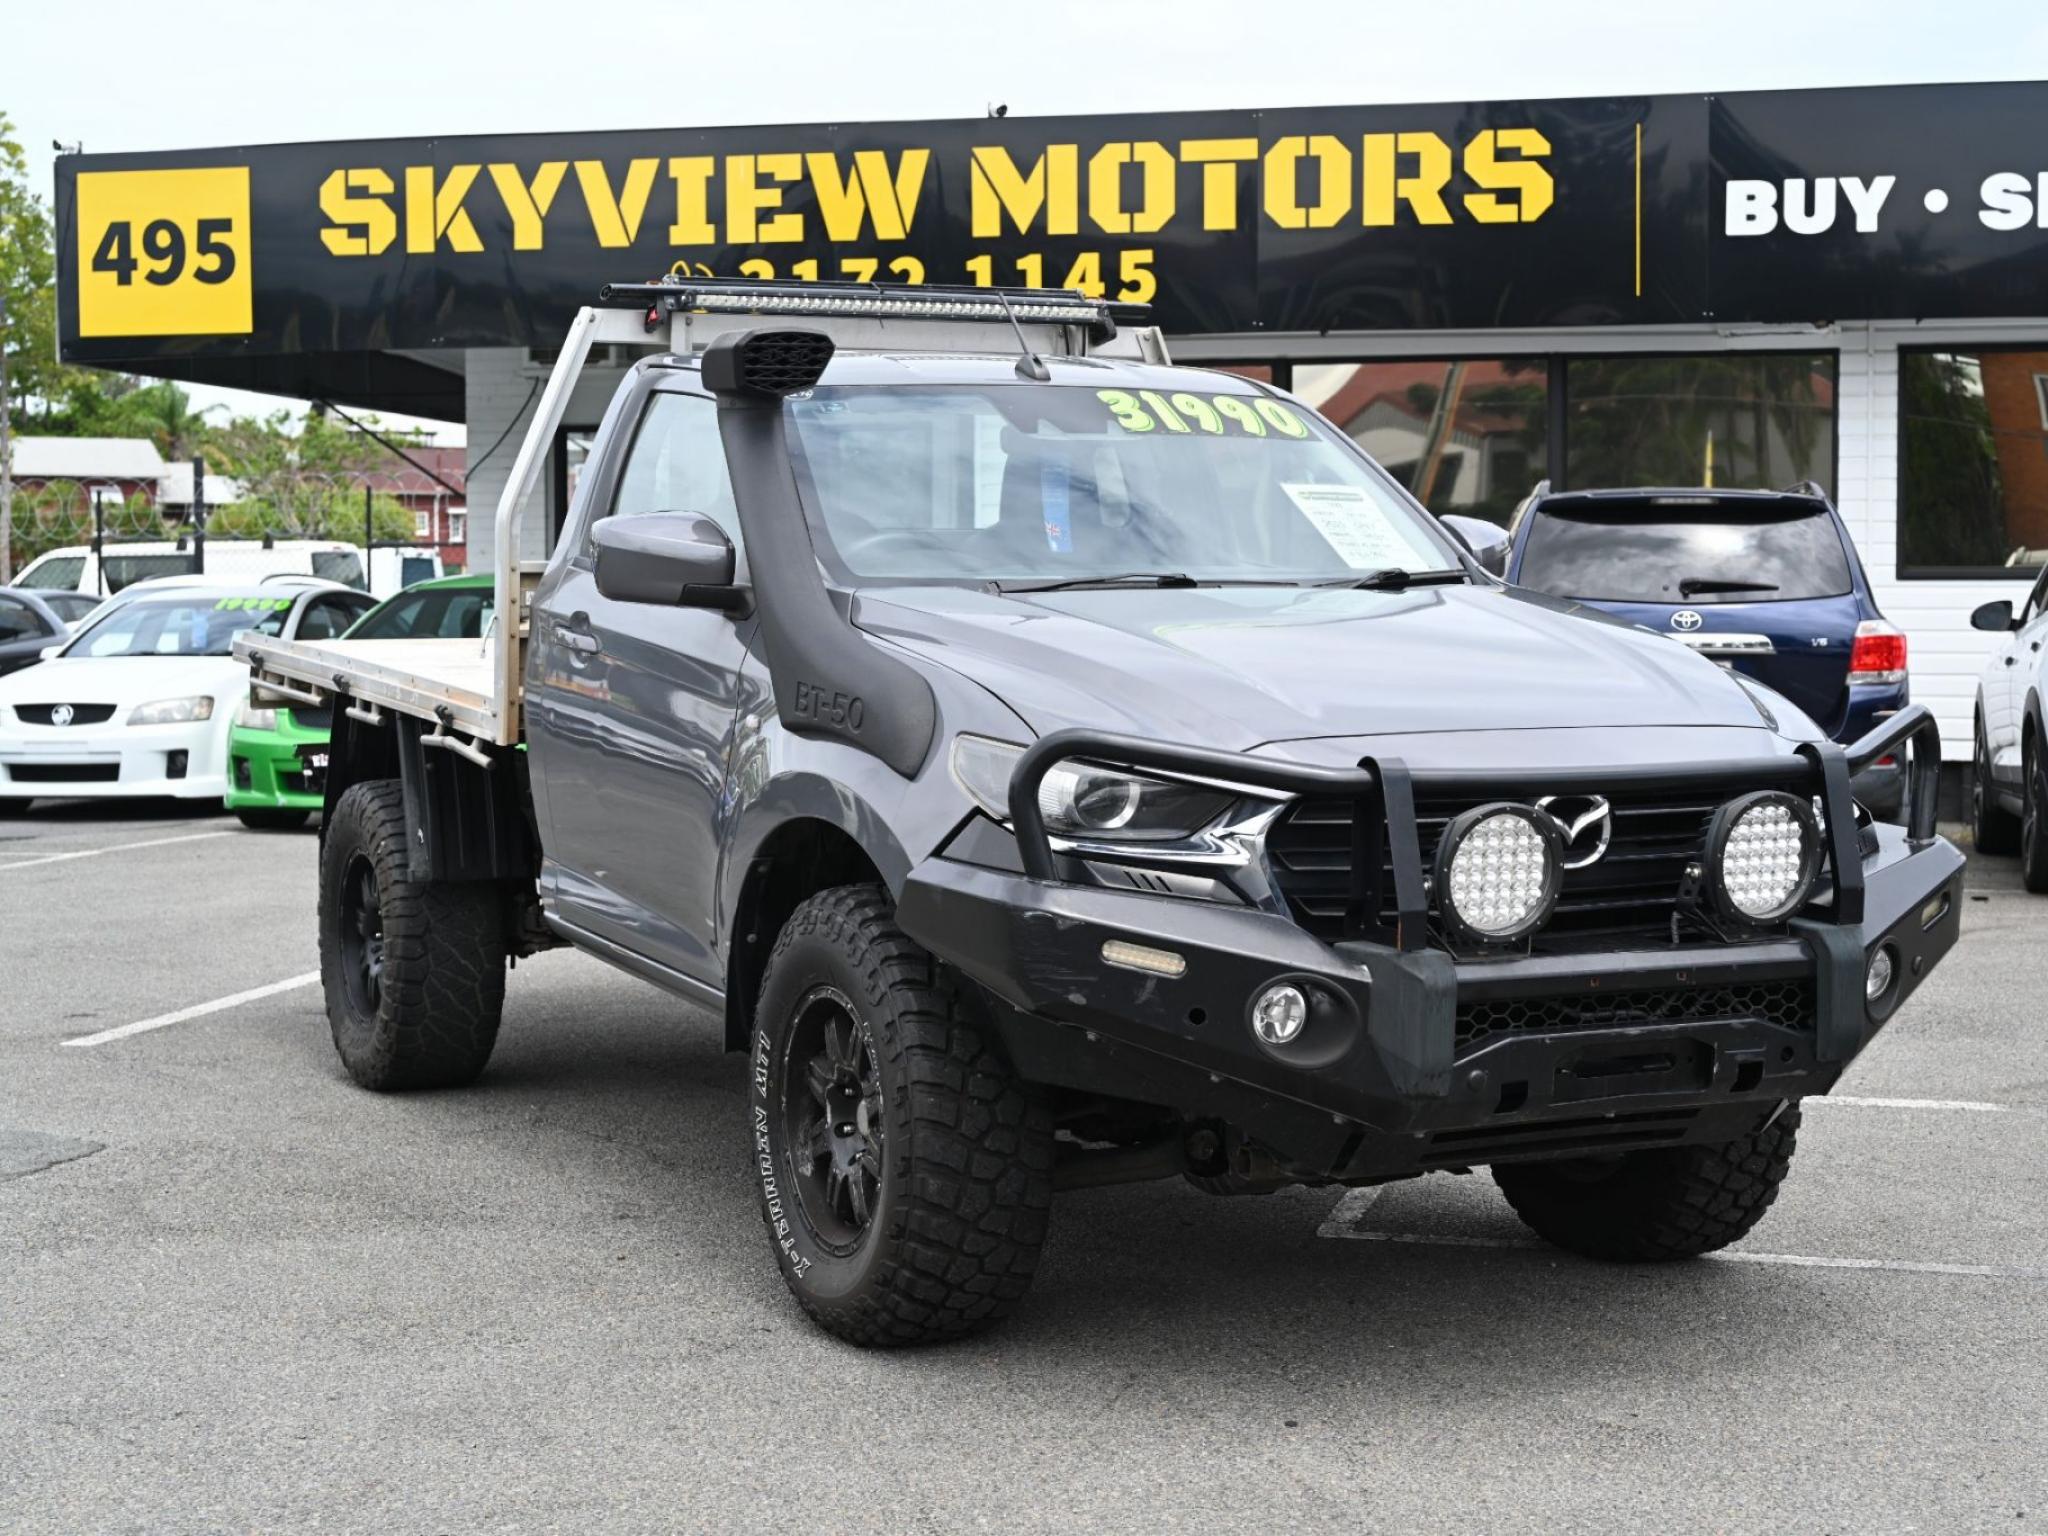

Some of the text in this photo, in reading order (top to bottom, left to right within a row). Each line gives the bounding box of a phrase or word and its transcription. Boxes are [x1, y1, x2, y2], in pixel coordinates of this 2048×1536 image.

[320, 129, 1554, 256] SKYVIEW MOTORS
[1725, 171, 2048, 236] BUY S
[92, 218, 235, 285] 495
[966, 250, 1157, 304] 1145
[1096, 390, 1308, 439] 31990
[795, 681, 865, 734] BT-50
